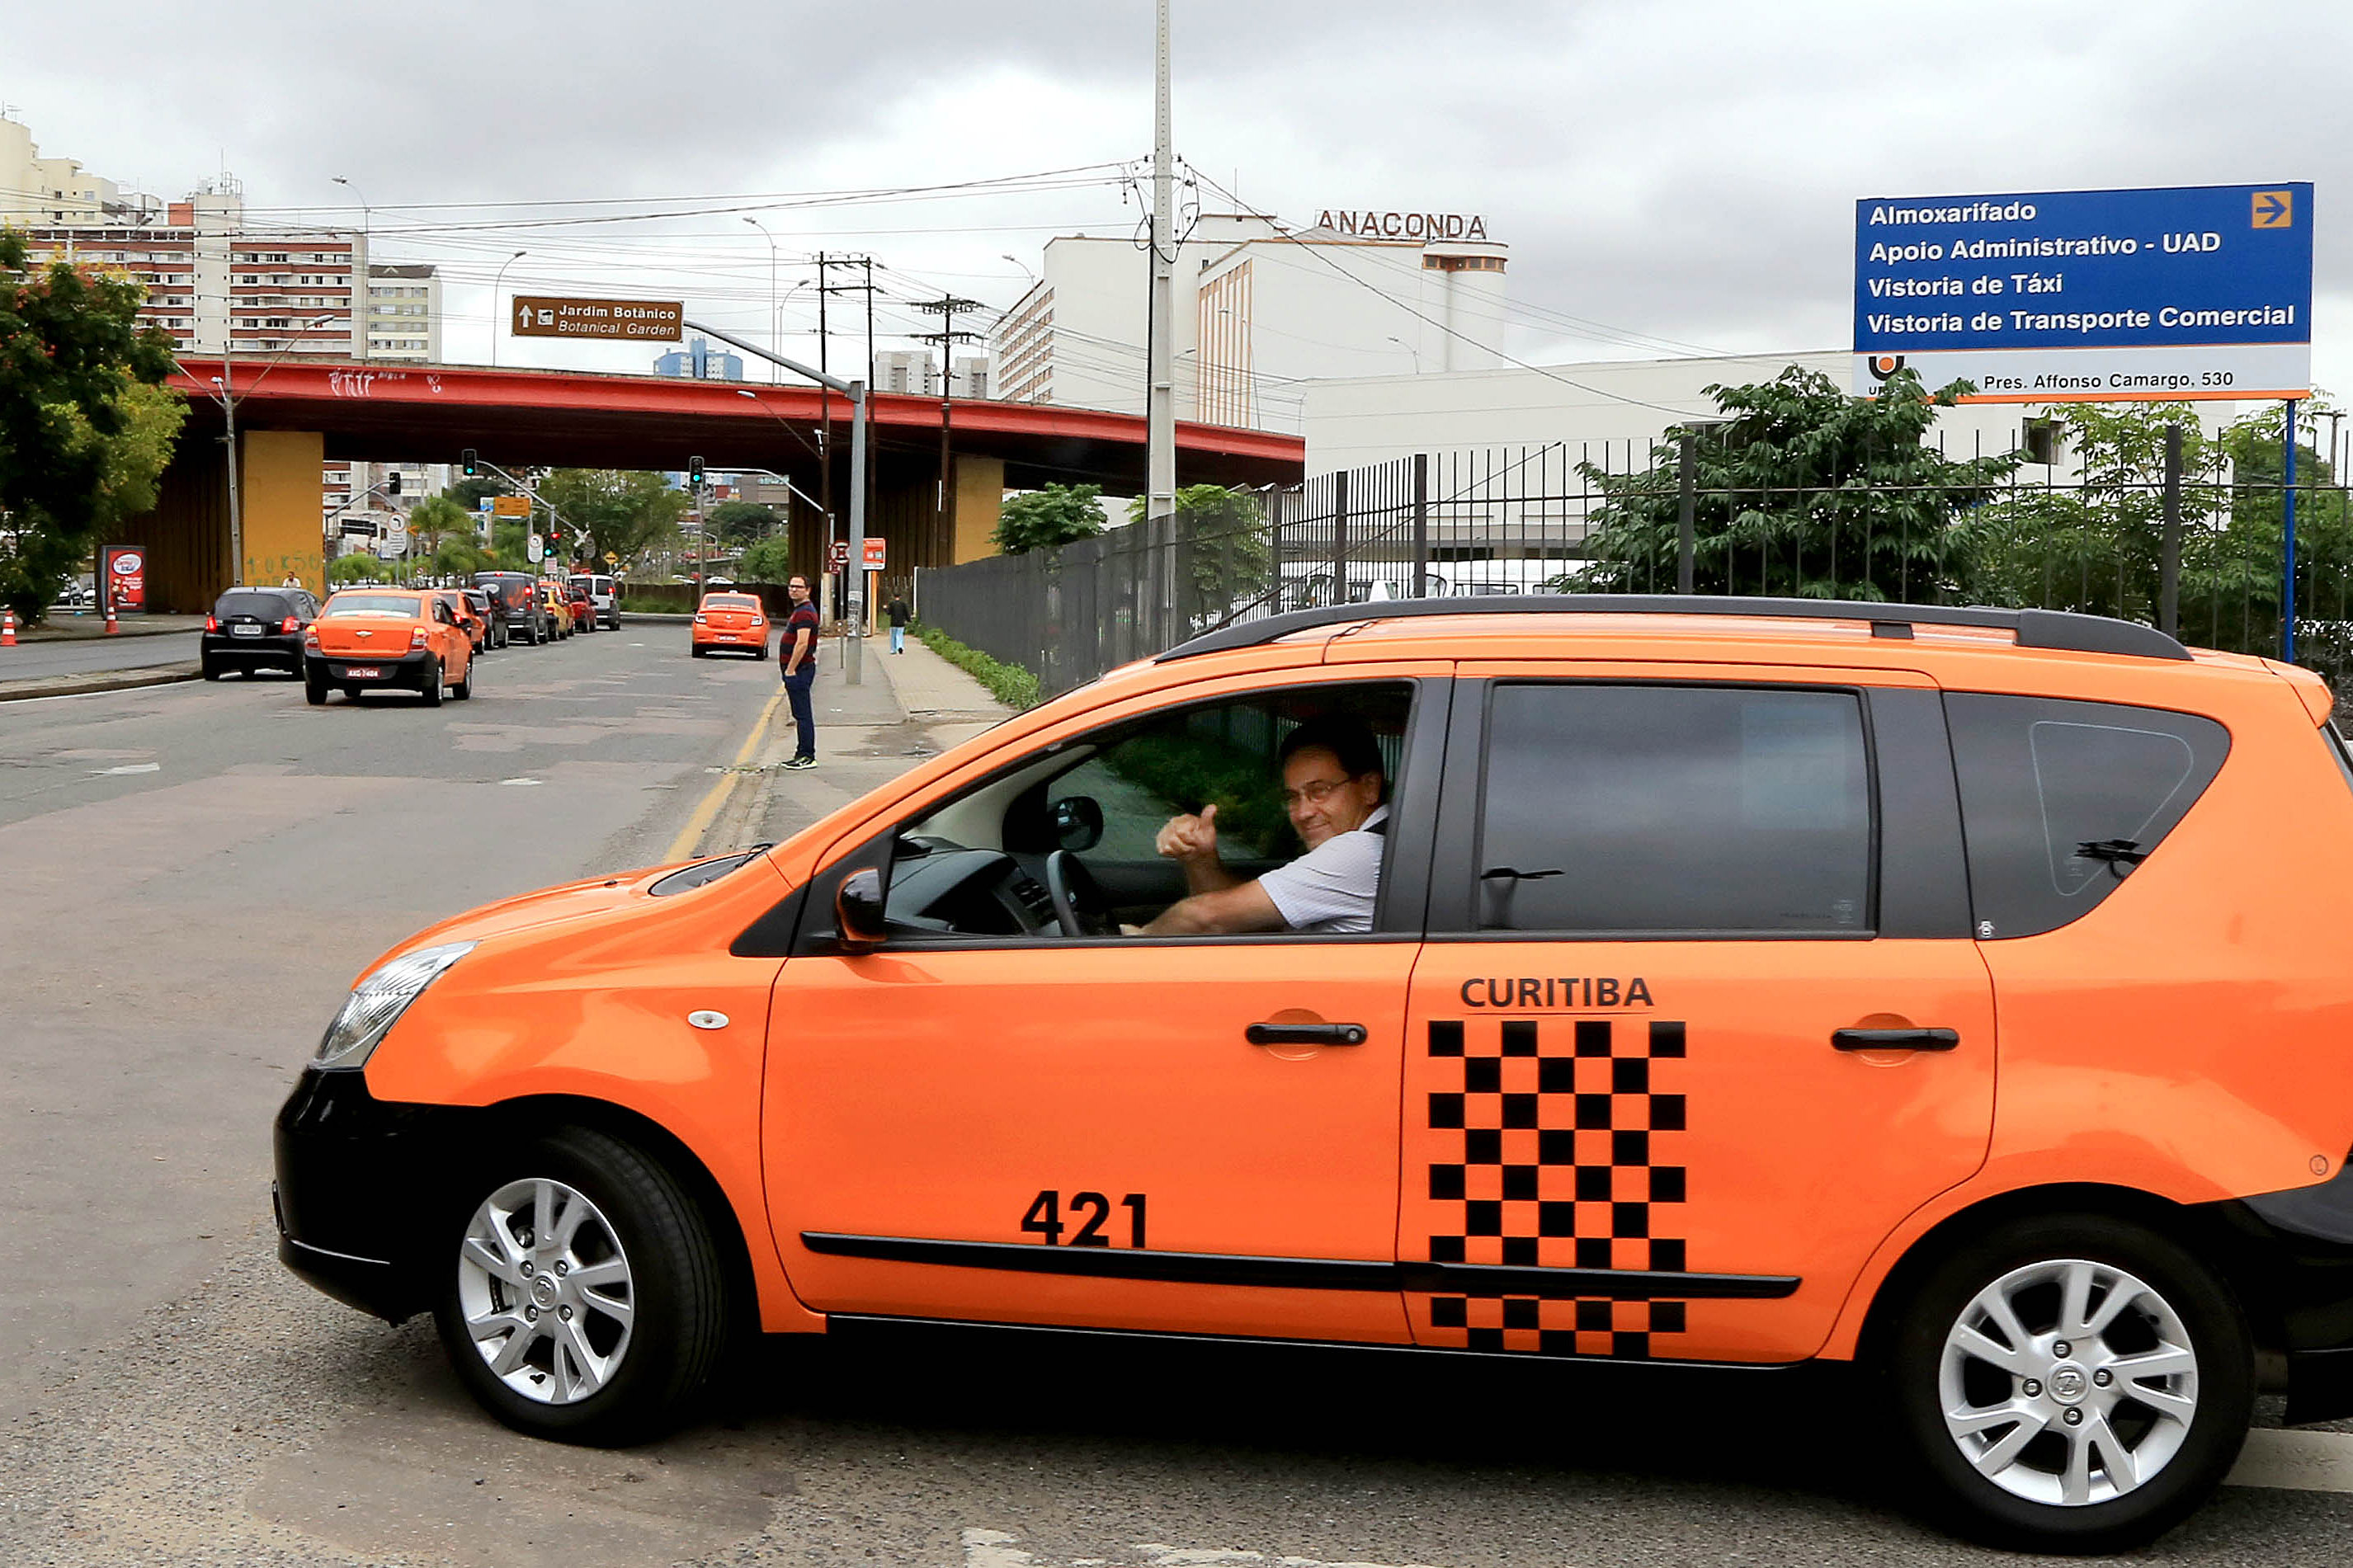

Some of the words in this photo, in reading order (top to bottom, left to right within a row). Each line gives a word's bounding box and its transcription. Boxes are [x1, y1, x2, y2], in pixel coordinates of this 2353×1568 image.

[1319, 210, 1487, 239] ANACONDA
[1870, 200, 2036, 226] Almoxarifado
[1870, 242, 1943, 265] Apoio
[1950, 235, 2138, 258] Administrativo
[2162, 233, 2221, 253] UAD
[1869, 276, 1964, 297] Vistoria
[1971, 275, 2003, 294] de
[2011, 272, 2063, 294] Táxi
[559, 304, 608, 318] Jardim
[614, 307, 676, 320] Botânico
[1868, 312, 1963, 333] Vistoria
[1970, 310, 2002, 331] de
[2009, 308, 2151, 334] Transporte
[2158, 304, 2294, 327] Comercial
[559, 320, 620, 334] Botanical
[626, 323, 675, 336] Garden
[1984, 376, 2028, 389] Pres.
[2034, 374, 2101, 388] Affonso
[2110, 373, 2195, 390] Camargo,
[2201, 371, 2233, 386] 530
[1461, 977, 1654, 1008] CURITIBA
[1021, 1190, 1146, 1250] 421
